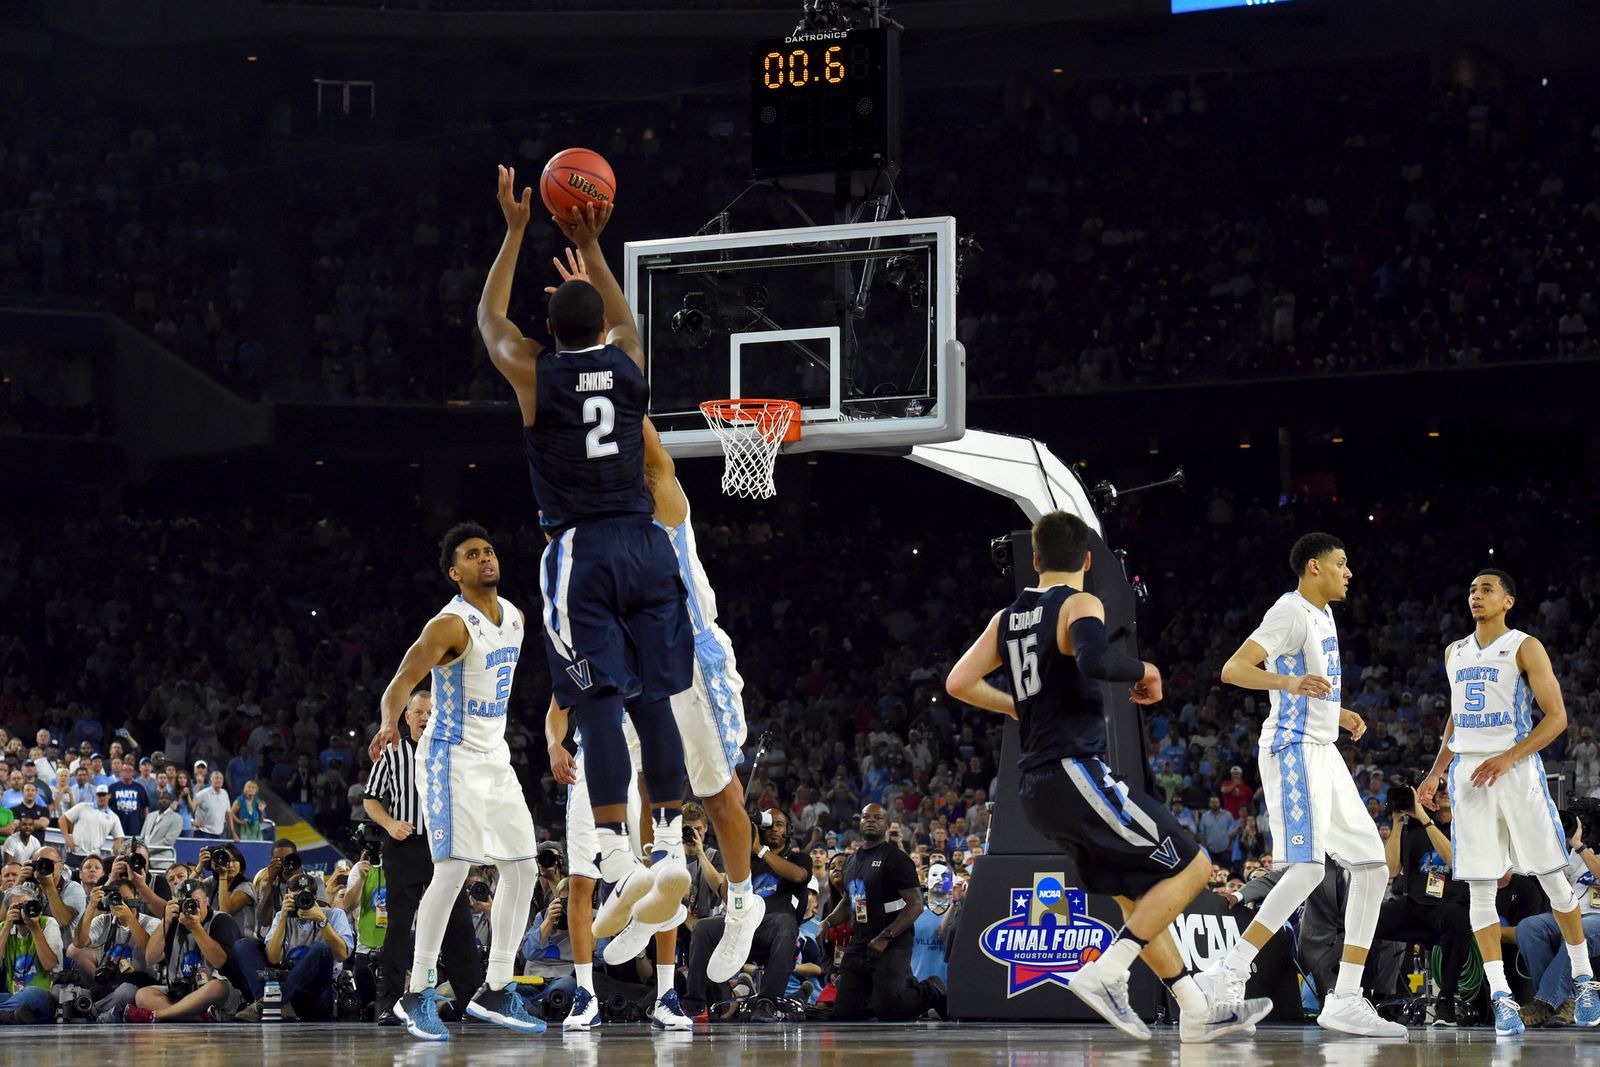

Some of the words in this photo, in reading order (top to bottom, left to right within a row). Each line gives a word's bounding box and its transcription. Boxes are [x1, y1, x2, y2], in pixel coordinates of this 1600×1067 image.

[785, 31, 847, 43] DAKTRONICS
[764, 46, 845, 89] 00.6
[567, 172, 609, 202] Wilson
[575, 370, 614, 392] JENKINS
[582, 395, 619, 459] 2
[1006, 633, 1042, 702] 15
[1455, 666, 1500, 684] NORTH
[495, 665, 512, 701] 2
[1464, 682, 1486, 711] 5
[115, 790, 138, 799] PARTY
[1038, 889, 1061, 899] NCAA
[995, 929, 1049, 951] FINAL
[1052, 928, 1104, 951] FOUR
